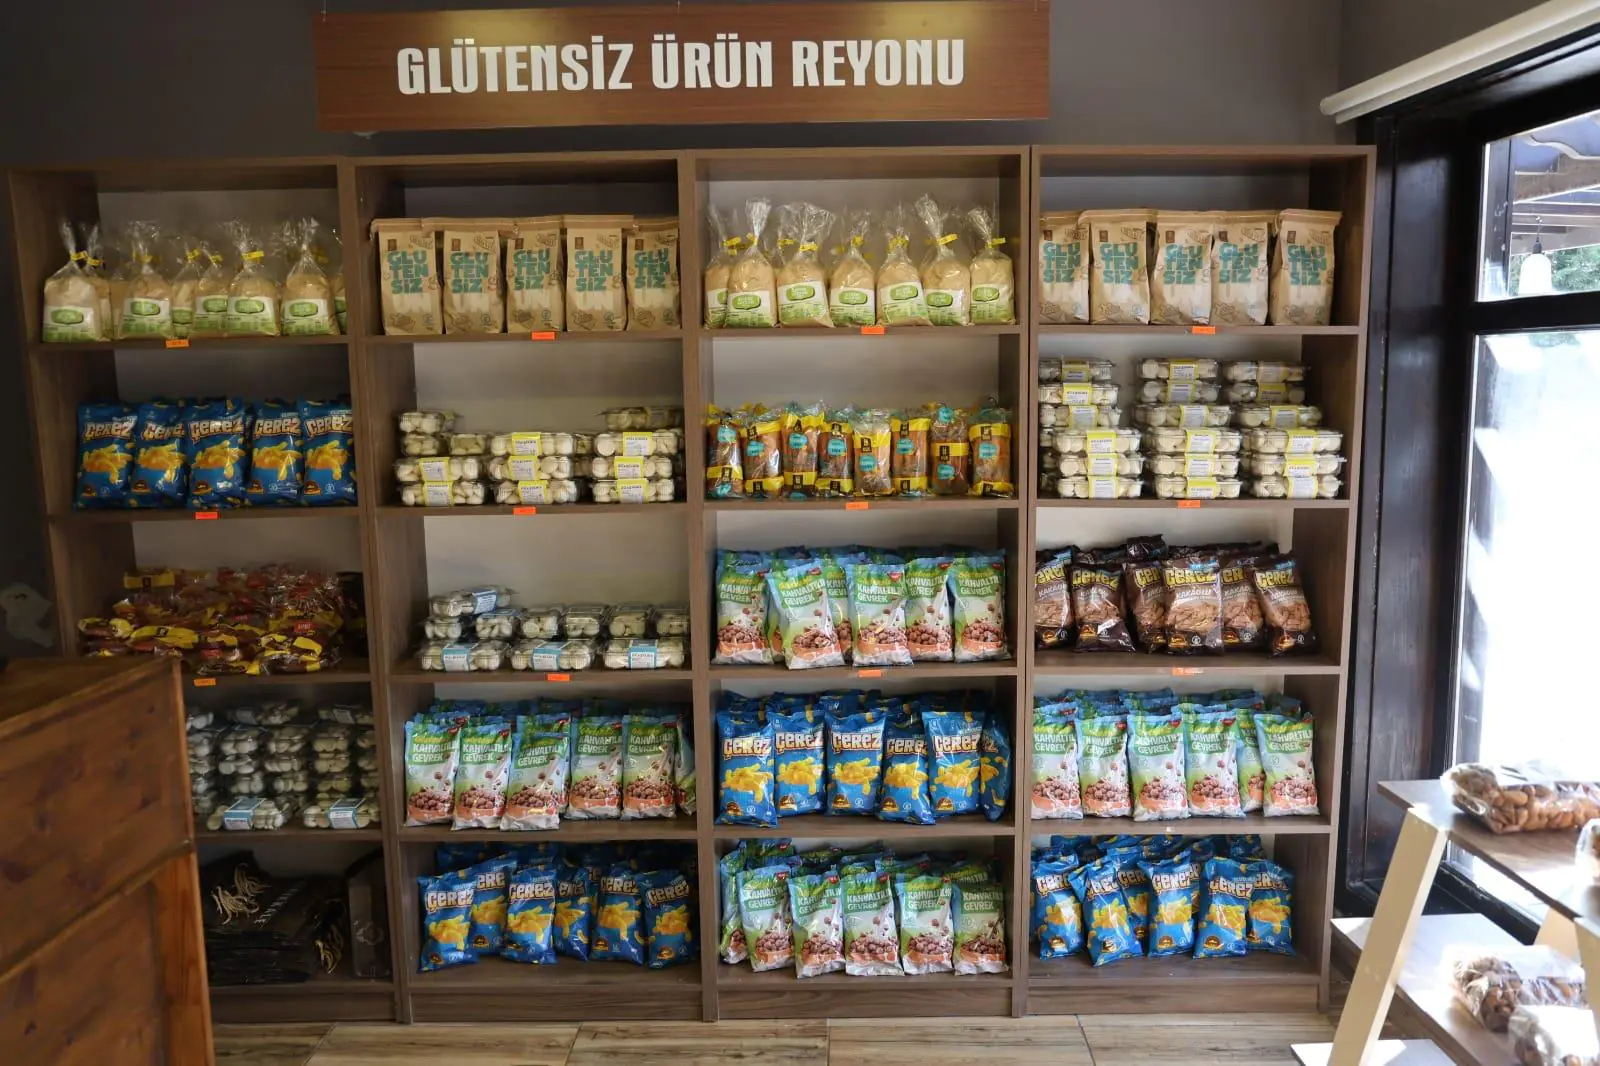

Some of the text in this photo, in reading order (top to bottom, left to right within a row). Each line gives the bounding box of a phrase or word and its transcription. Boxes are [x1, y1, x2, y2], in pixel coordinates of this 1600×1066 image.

[397, 33, 965, 95] GLÜTENSİZ ÜRÜN REYONU
[577, 744, 608, 754] GEVREK
[1034, 743, 1066, 752] GEVREK
[1137, 744, 1170, 754] GEVREK
[1191, 742, 1221, 751] GEVREK
[1271, 741, 1301, 751] GEVREK
[412, 753, 443, 762] GEVREK
[463, 753, 493, 762] GEVREK
[518, 755, 548, 767] GEVREK
[847, 902, 878, 911] GEVREK
[908, 900, 937, 909] GEVREK
[964, 901, 994, 911] GEVREK
